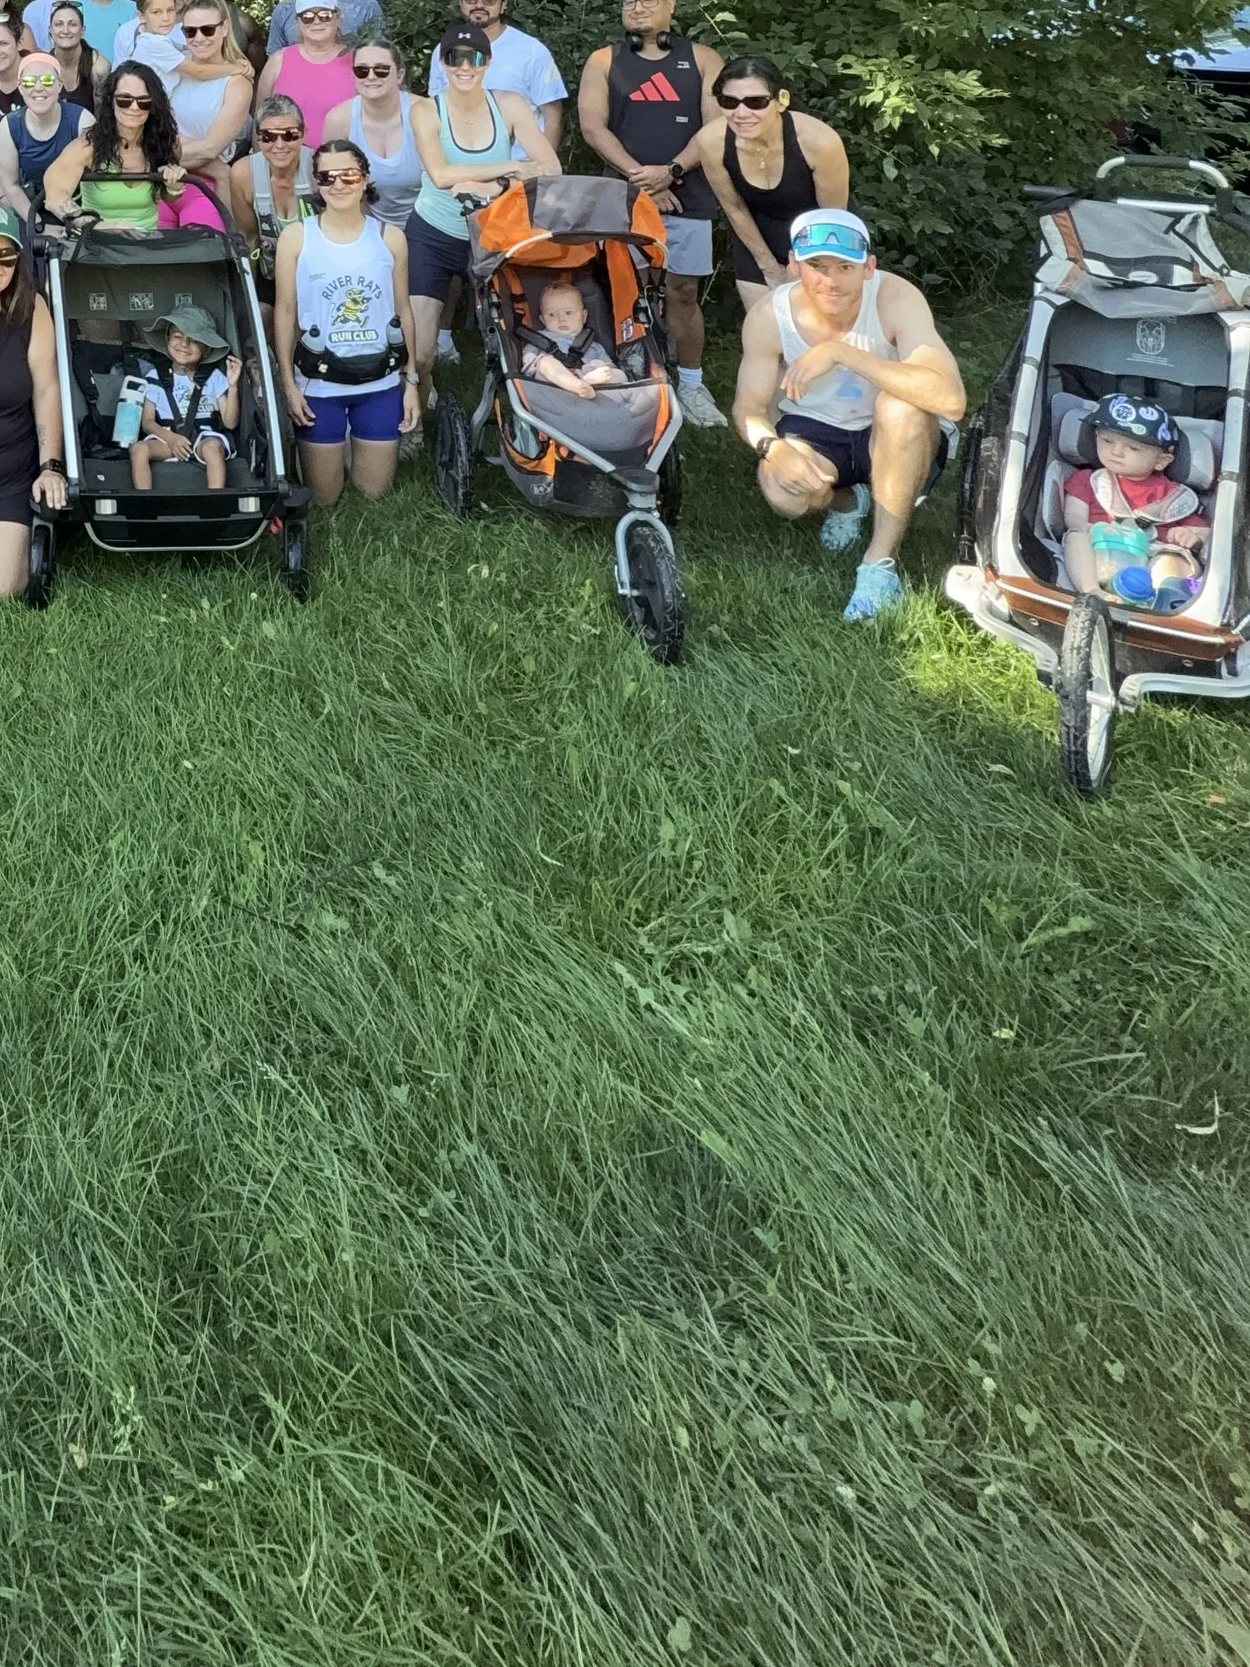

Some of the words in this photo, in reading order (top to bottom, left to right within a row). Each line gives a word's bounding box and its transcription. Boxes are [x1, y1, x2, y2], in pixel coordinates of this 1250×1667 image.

[322, 275, 353, 300] RIVER
[357, 275, 383, 299] RATS
[331, 331, 352, 342] RUN
[353, 330, 377, 340] CLUB
